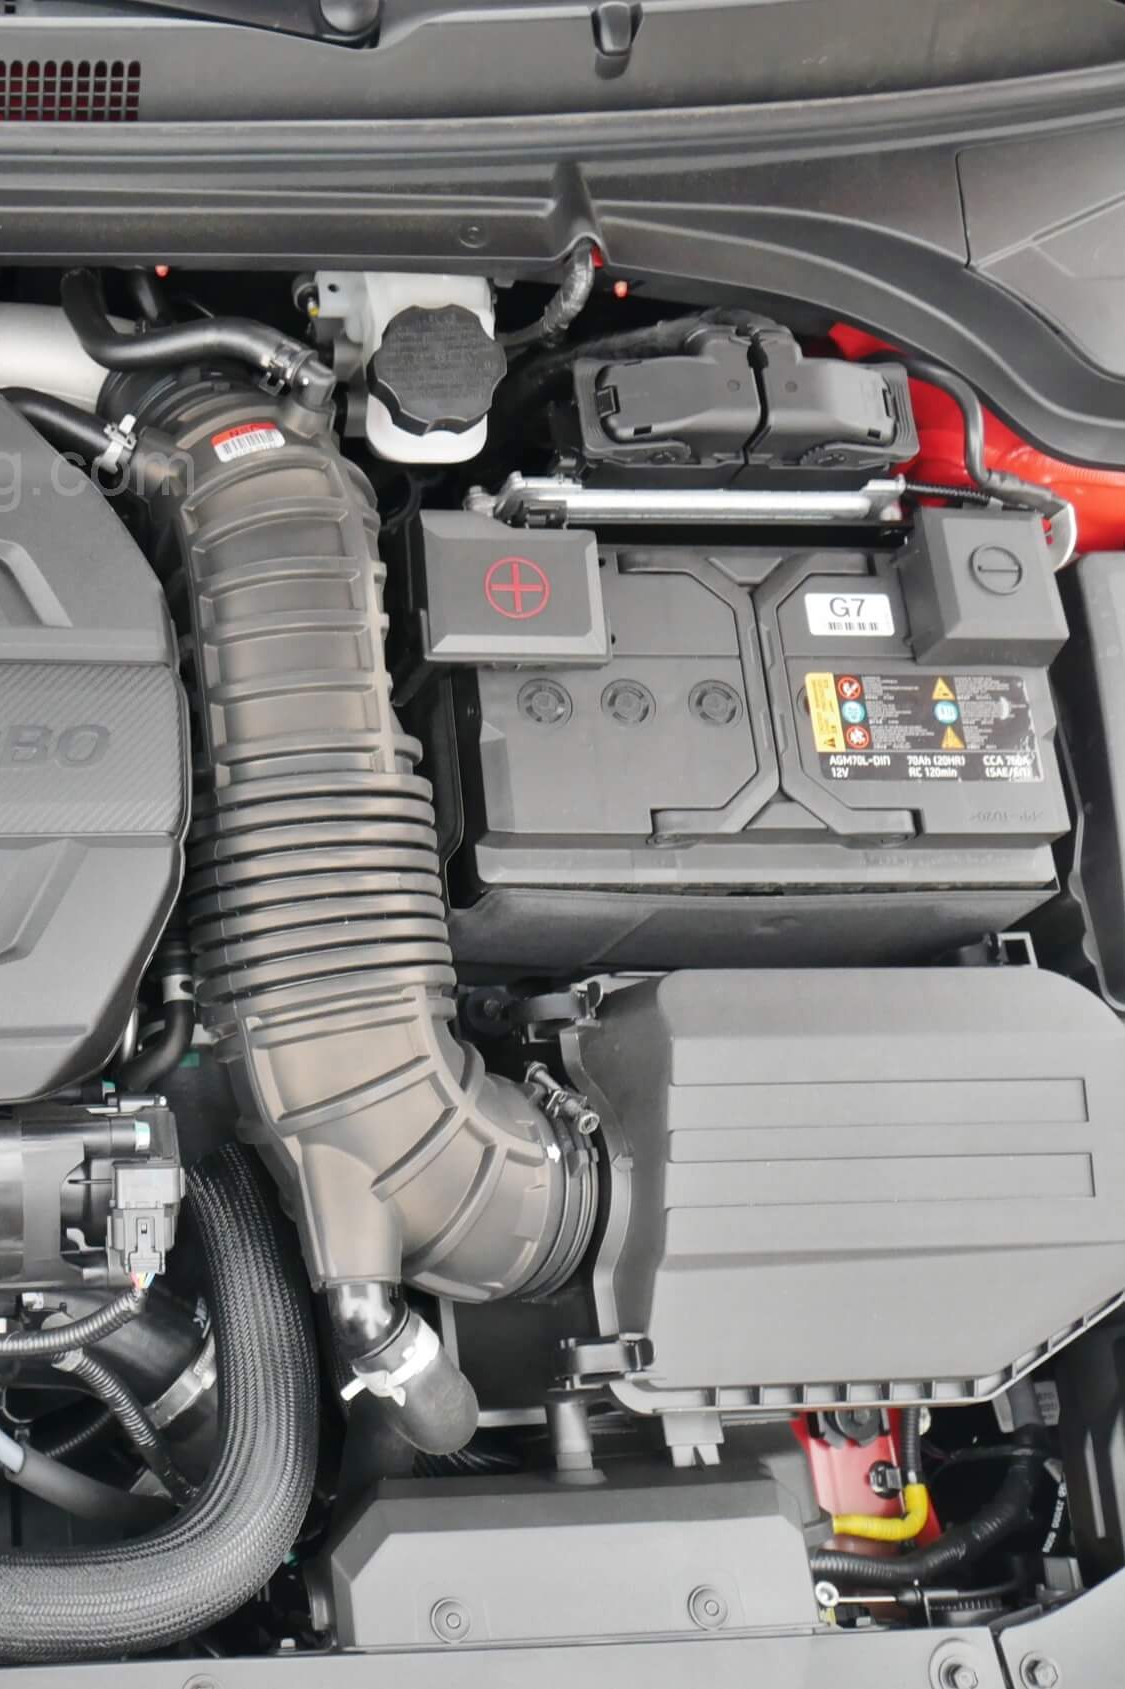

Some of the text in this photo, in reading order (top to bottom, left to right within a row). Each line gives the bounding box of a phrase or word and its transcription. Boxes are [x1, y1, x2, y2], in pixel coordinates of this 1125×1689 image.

[829, 597, 866, 618] G7
[983, 754, 1004, 767] CCA
[831, 766, 849, 778] 12V
[908, 766, 958, 778] RC 120min
